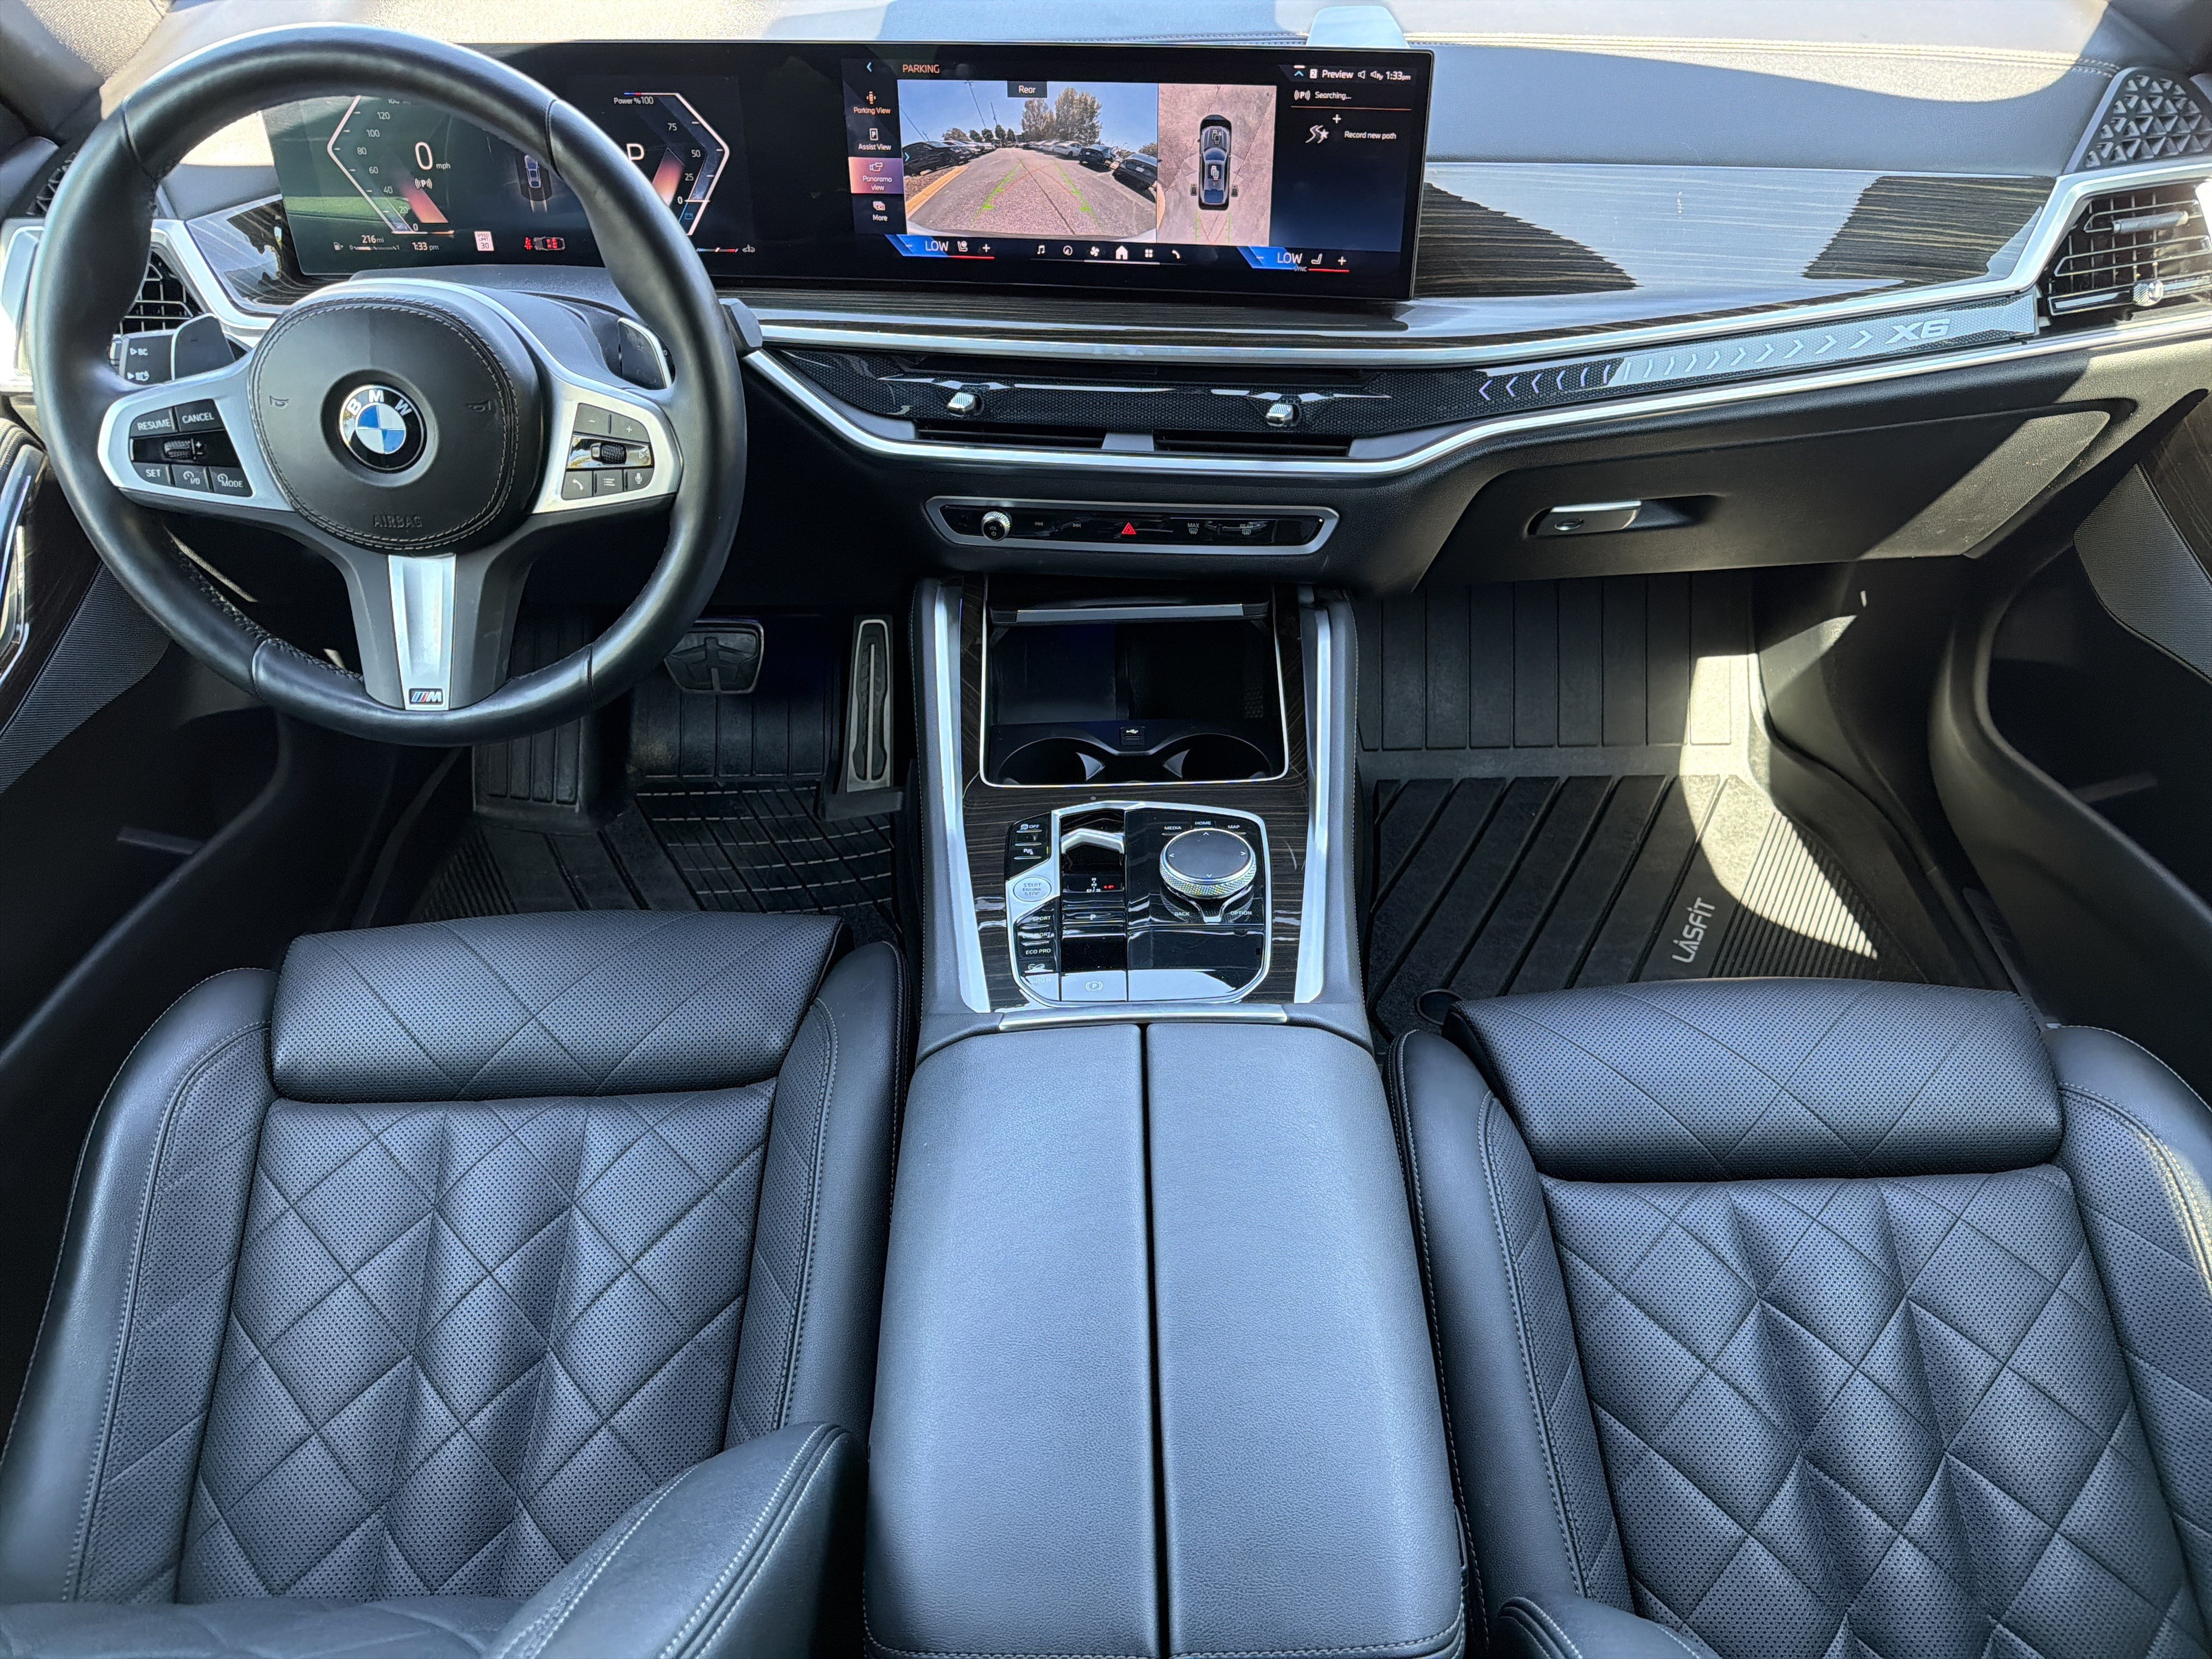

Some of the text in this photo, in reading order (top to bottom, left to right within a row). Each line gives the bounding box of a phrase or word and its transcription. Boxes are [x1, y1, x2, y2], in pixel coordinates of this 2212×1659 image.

[902, 64, 940, 74] PARKING
[1322, 69, 1354, 79] Preview
[1018, 84, 1036, 94] Rear
[1314, 91, 1352, 101] Searching...
[853, 106, 875, 115] Parking
[377, 111, 391, 120] 120
[667, 123, 678, 131] 75
[366, 129, 380, 137] 100
[1344, 131, 1367, 139] Record
[357, 146, 367, 155] 80
[691, 149, 701, 158] 50
[415, 142, 451, 171] 0 mph
[383, 186, 393, 194] 40
[677, 196, 682, 204] 0
[398, 206, 408, 214] 20
[412, 242, 428, 251] 1:33
[925, 240, 949, 252] LOW
[1277, 252, 1303, 264] LOW
[1885, 319, 1950, 345] X6
[347, 389, 413, 416] BMW
[182, 412, 215, 424] CANCEL
[137, 419, 171, 431] RESUME
[145, 469, 161, 477] SET
[222, 479, 244, 488] MODE
[373, 514, 423, 529] AIRBAG
